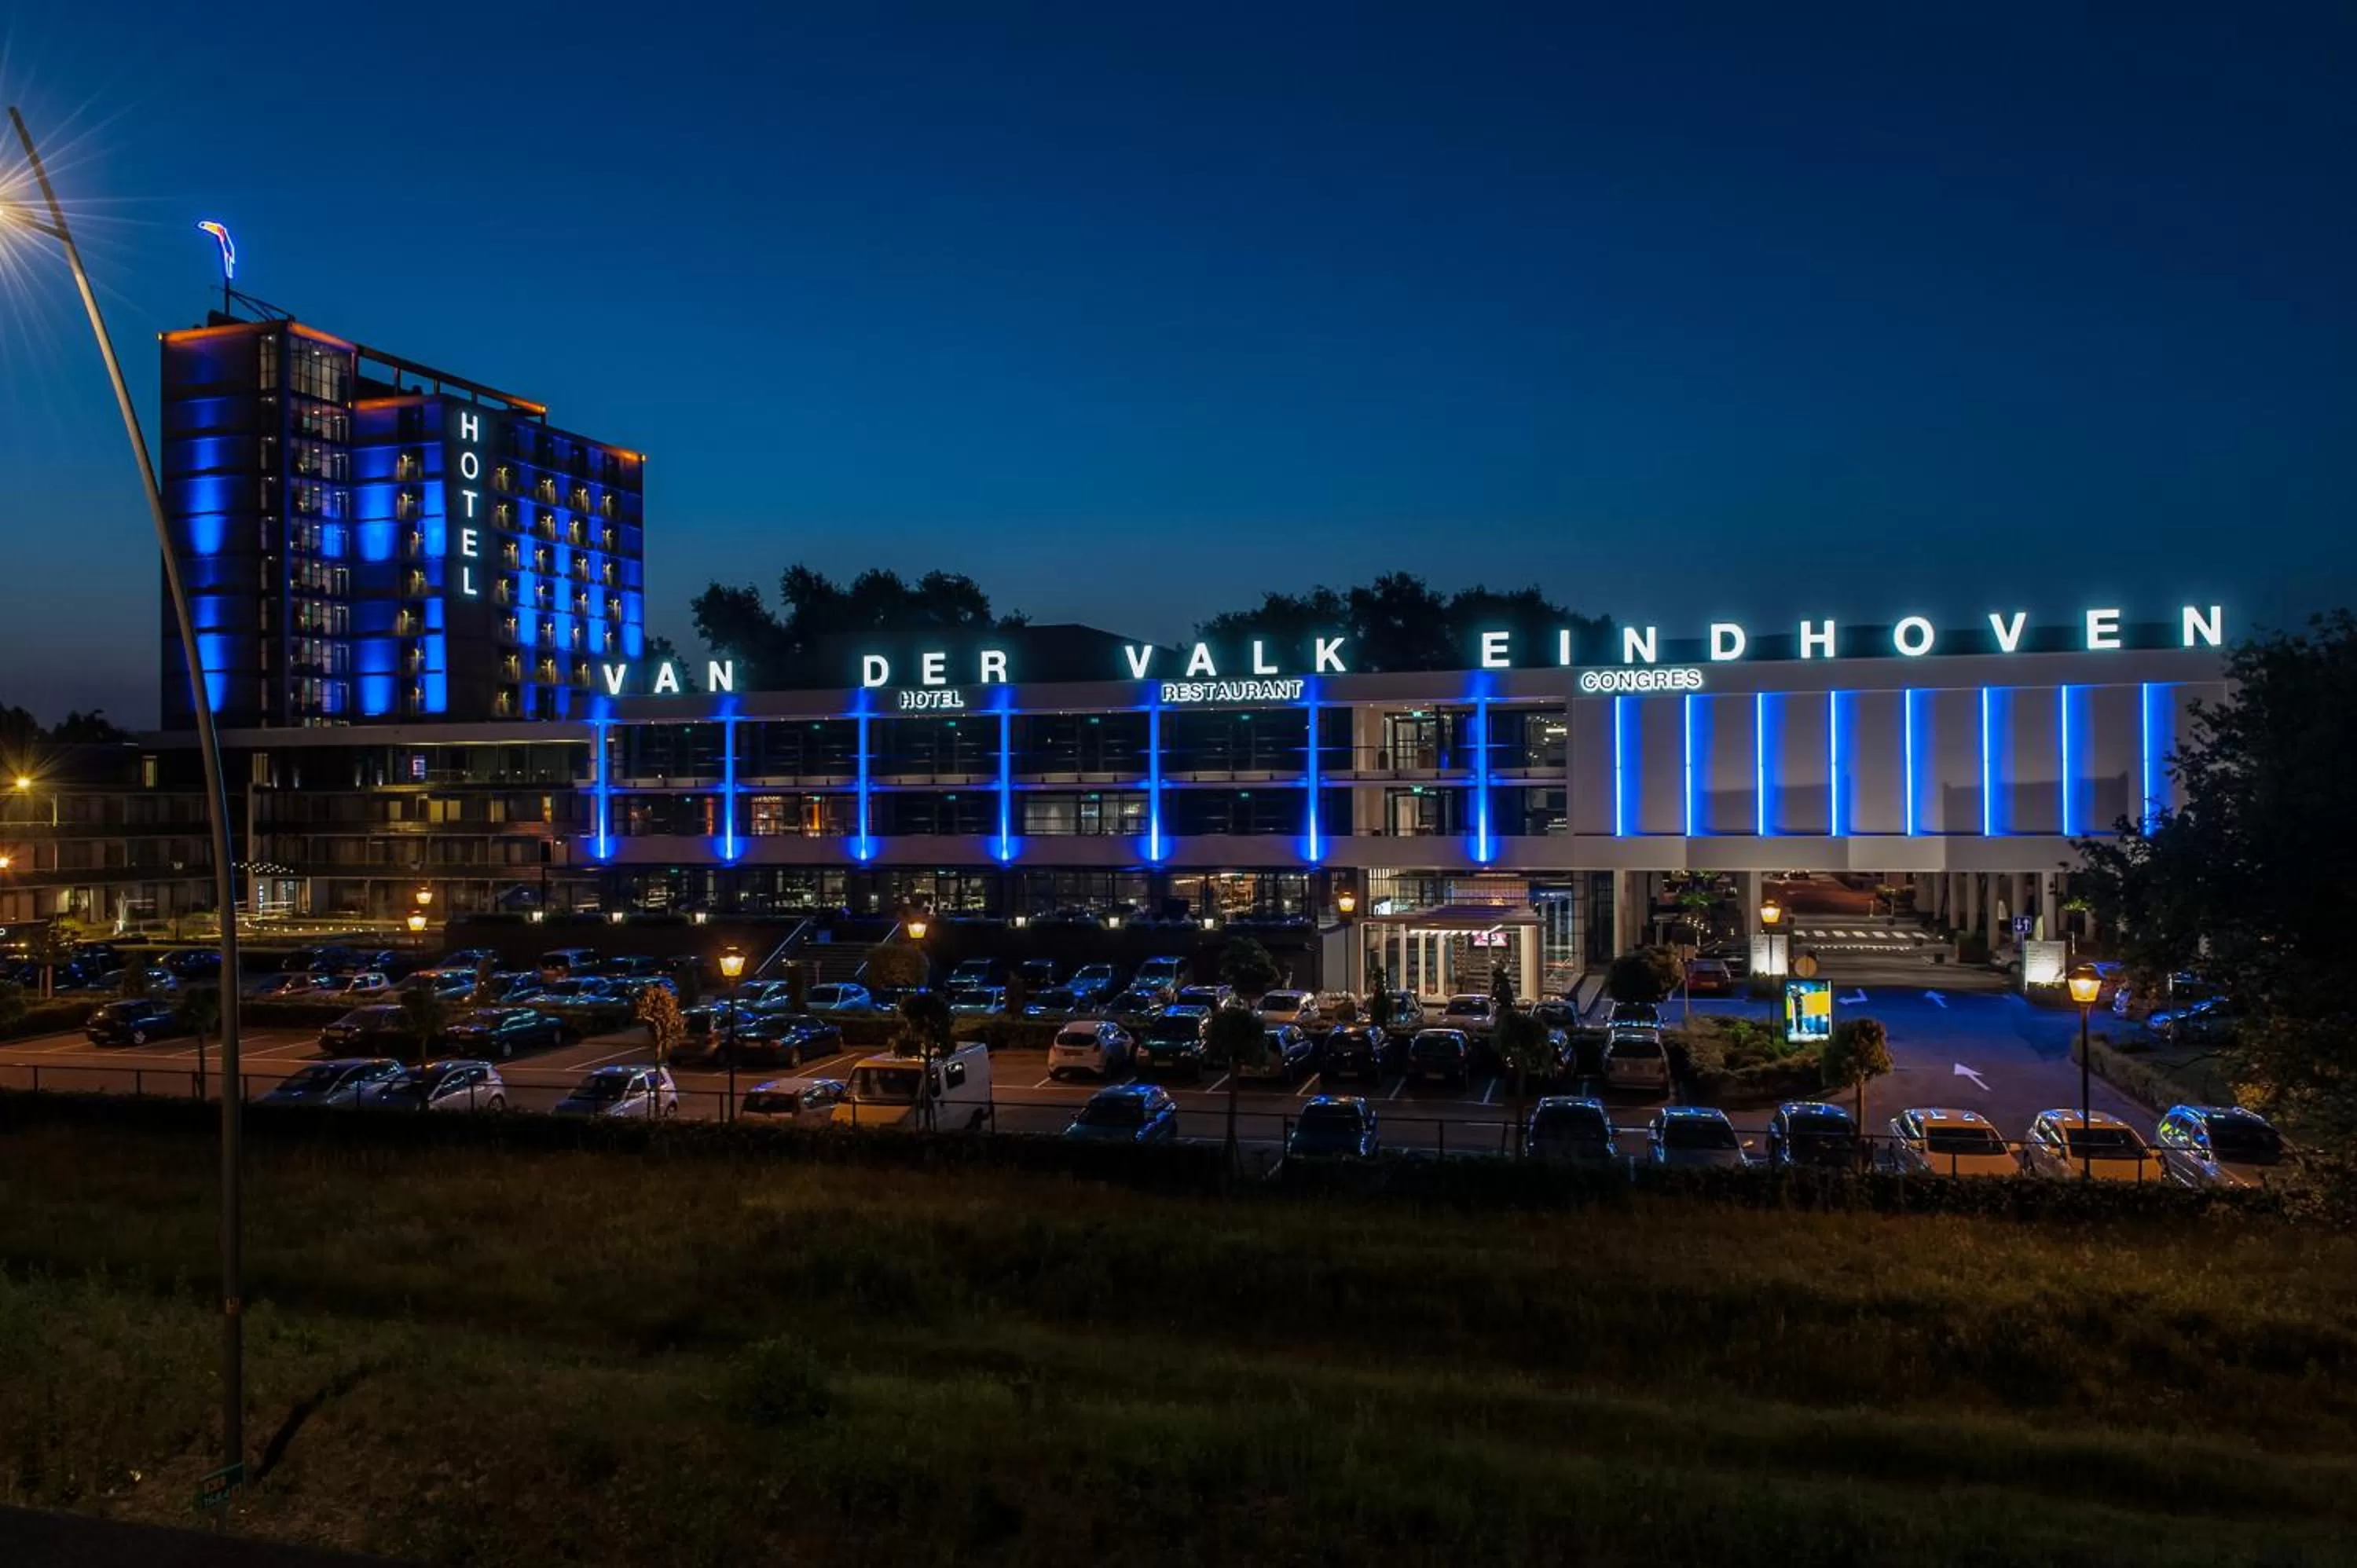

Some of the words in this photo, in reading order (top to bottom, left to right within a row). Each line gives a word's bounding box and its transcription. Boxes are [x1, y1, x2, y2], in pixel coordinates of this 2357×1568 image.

[460, 411, 479, 595] HOTEL
[602, 659, 734, 696] VAN
[863, 649, 1007, 688] DER
[1124, 636, 1347, 680] VALK
[1481, 605, 2222, 669] EINDHOVEN
[1161, 680, 1304, 702] RESTAURANT
[1579, 668, 1704, 693] CONGRES
[900, 690, 965, 710] HOTEL
